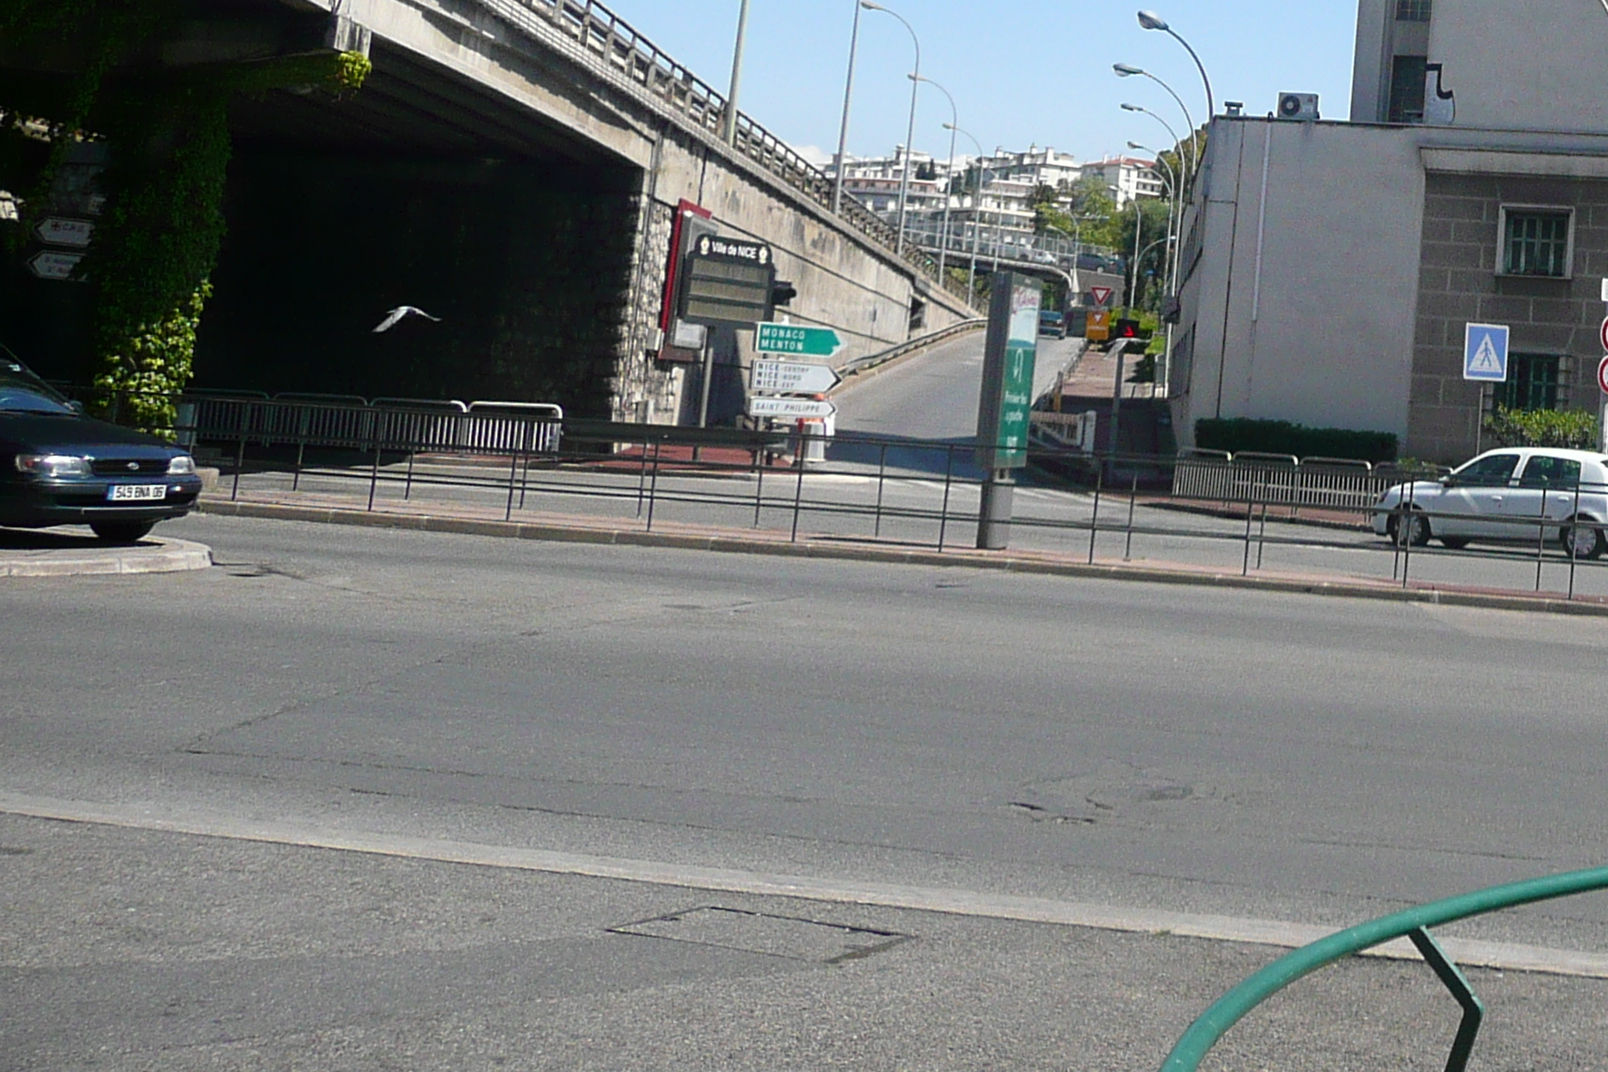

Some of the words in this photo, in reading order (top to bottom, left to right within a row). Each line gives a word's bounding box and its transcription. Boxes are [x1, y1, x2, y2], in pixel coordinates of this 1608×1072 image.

[711, 241, 727, 254] Ville
[727, 244, 737, 256] de
[738, 245, 757, 259] NICE
[762, 327, 805, 340] MONACO
[761, 338, 804, 351] MENTON
[755, 402, 780, 412] SAINT
[783, 403, 820, 413] PHILIPPE
